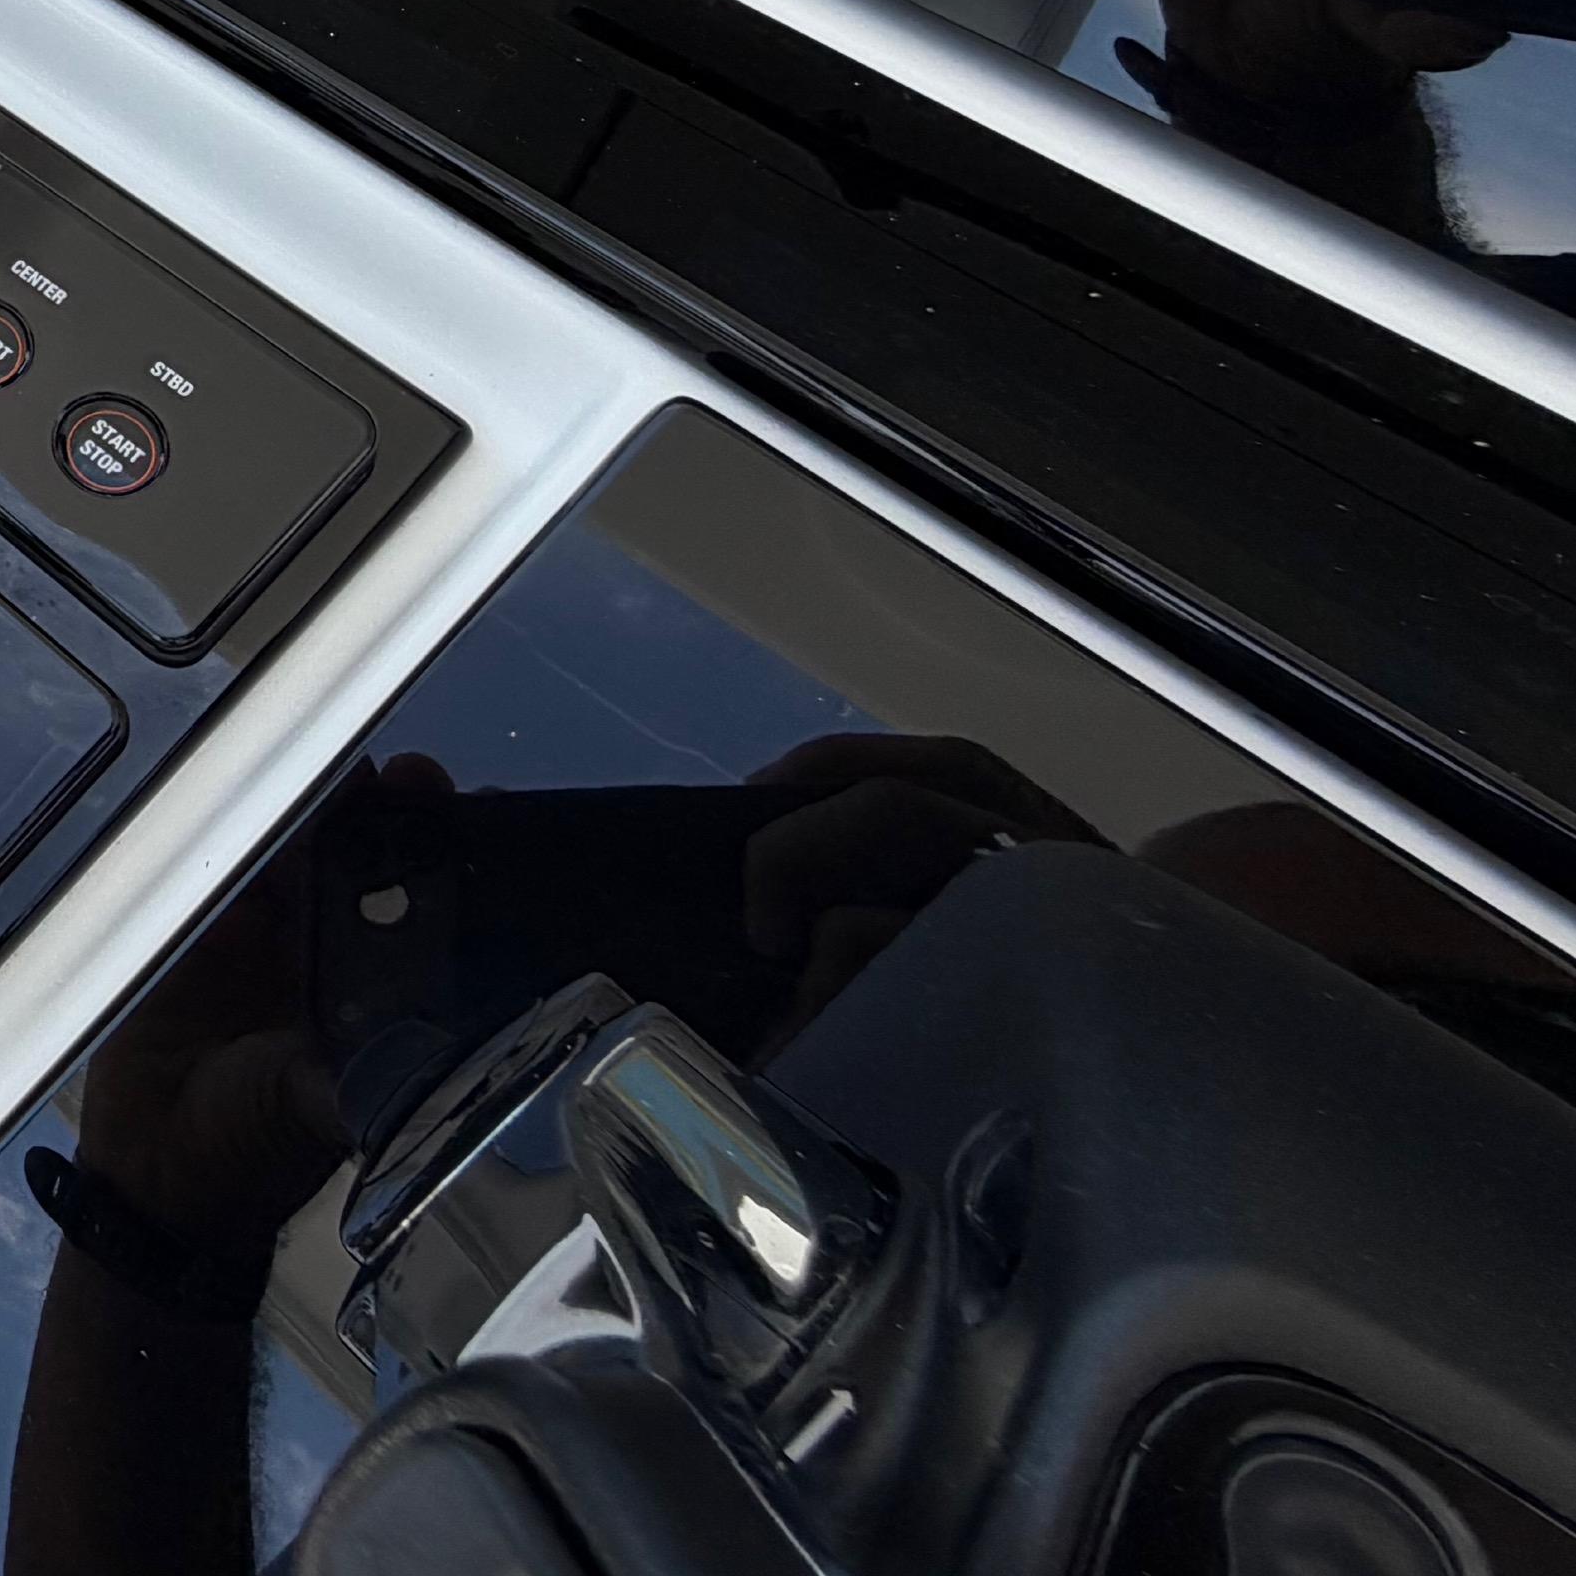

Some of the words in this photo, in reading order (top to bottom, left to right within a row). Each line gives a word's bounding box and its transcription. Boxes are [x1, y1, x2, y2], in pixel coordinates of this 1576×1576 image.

[10, 259, 68, 305] CENTER
[150, 360, 195, 399] STBD
[78, 438, 124, 476] STOP
[91, 418, 146, 464] START
